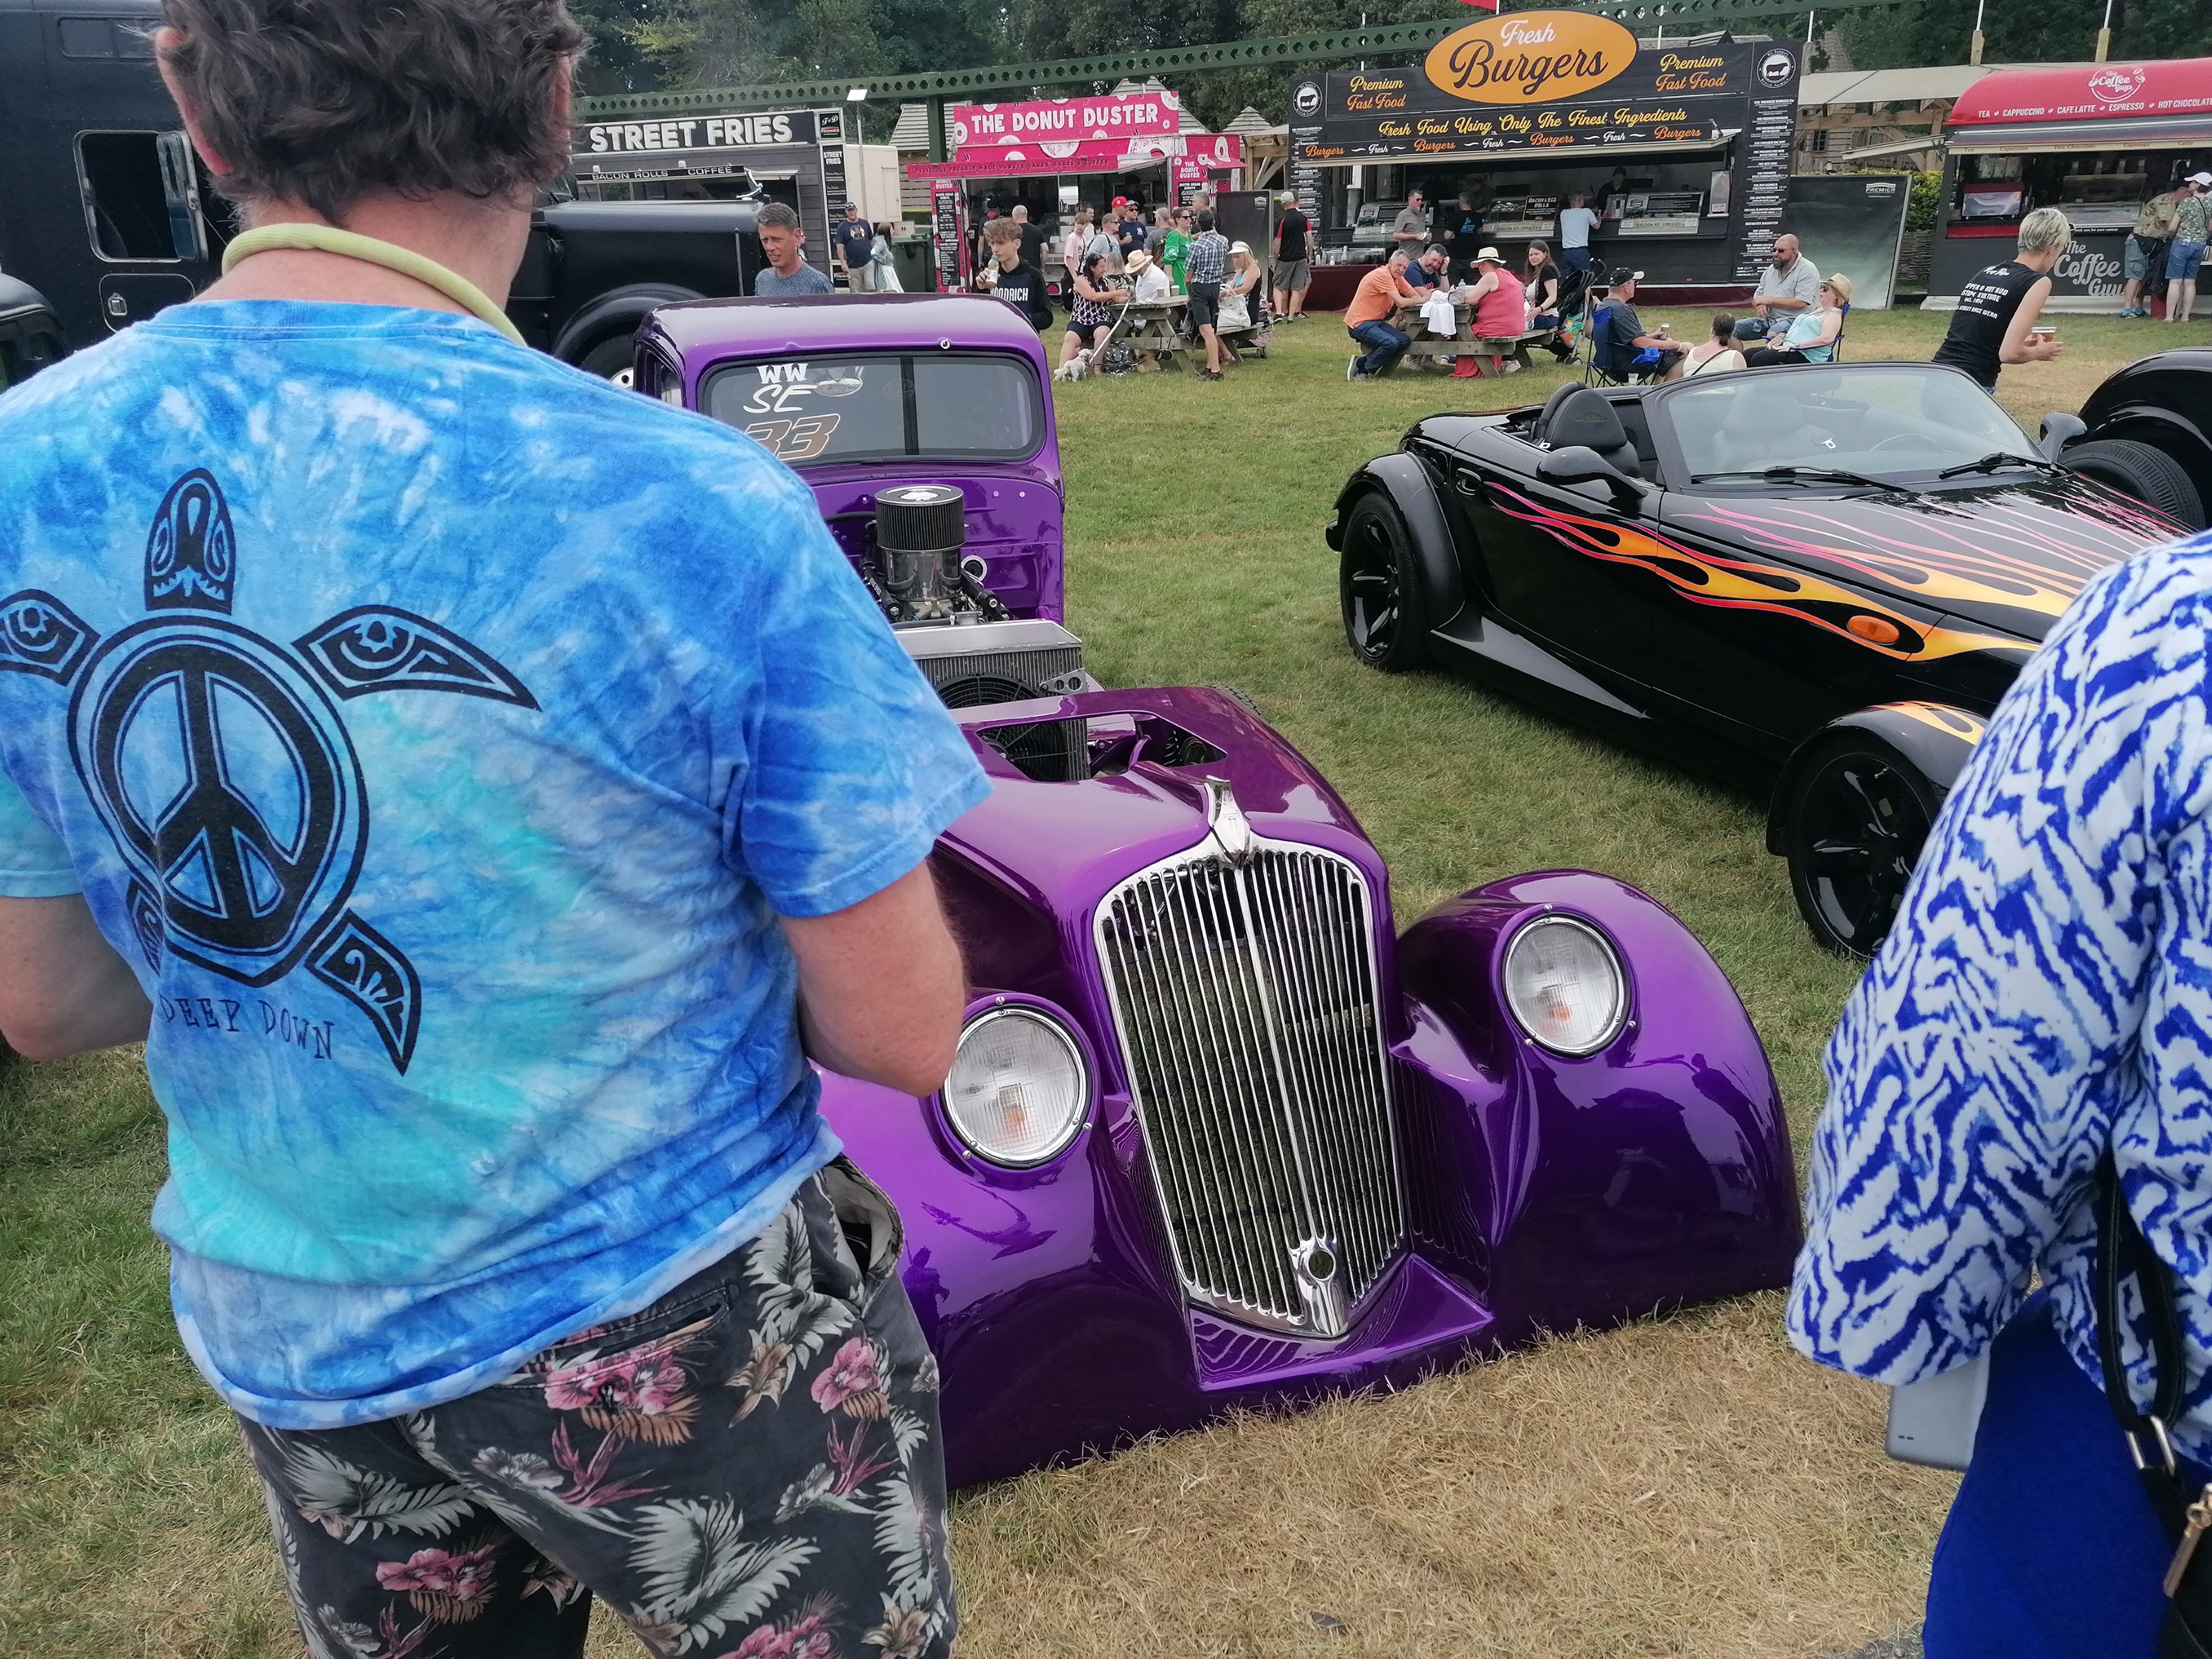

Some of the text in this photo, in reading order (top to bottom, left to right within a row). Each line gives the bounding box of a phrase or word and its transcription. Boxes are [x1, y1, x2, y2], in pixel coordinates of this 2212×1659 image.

[1500, 20, 1557, 47] Fresh
[1449, 39, 1608, 95] Burgers
[1660, 54, 1723, 73] Premium
[1349, 76, 1404, 93] Premium
[1655, 71, 1725, 92] Fast Food
[2098, 75, 2130, 87] Coffee
[2115, 84, 2132, 92] Guys
[1347, 92, 1406, 111] Fast Food
[2002, 107, 2045, 117] CAPPUCCINO
[2057, 106, 2074, 114] CAFE
[2074, 104, 2096, 113] LATTE
[2108, 102, 2144, 111] ESPRESSO
[2158, 100, 2173, 109] HOT
[971, 103, 1158, 133] THE DONUT DUSTER
[1378, 107, 1687, 137] Fresh Food Using Only The Finest Ingredients
[590, 115, 793, 152] STREET FRIES
[1306, 145, 1345, 158] Burgers
[1368, 143, 1389, 155] Fresh
[1414, 139, 1456, 153] Burgers
[1483, 138, 1504, 149] Fresh
[1530, 133, 1574, 147] Burgers
[1603, 131, 1626, 143] Fresh
[1654, 126, 1701, 141] Burgers
[592, 166, 732, 181] BACON ROLLS COFFEE
[2065, 241, 2086, 253] The
[2054, 253, 2122, 284] Coffee
[756, 363, 808, 384] WW
[157, 990, 335, 1060] DEEP DOWN
